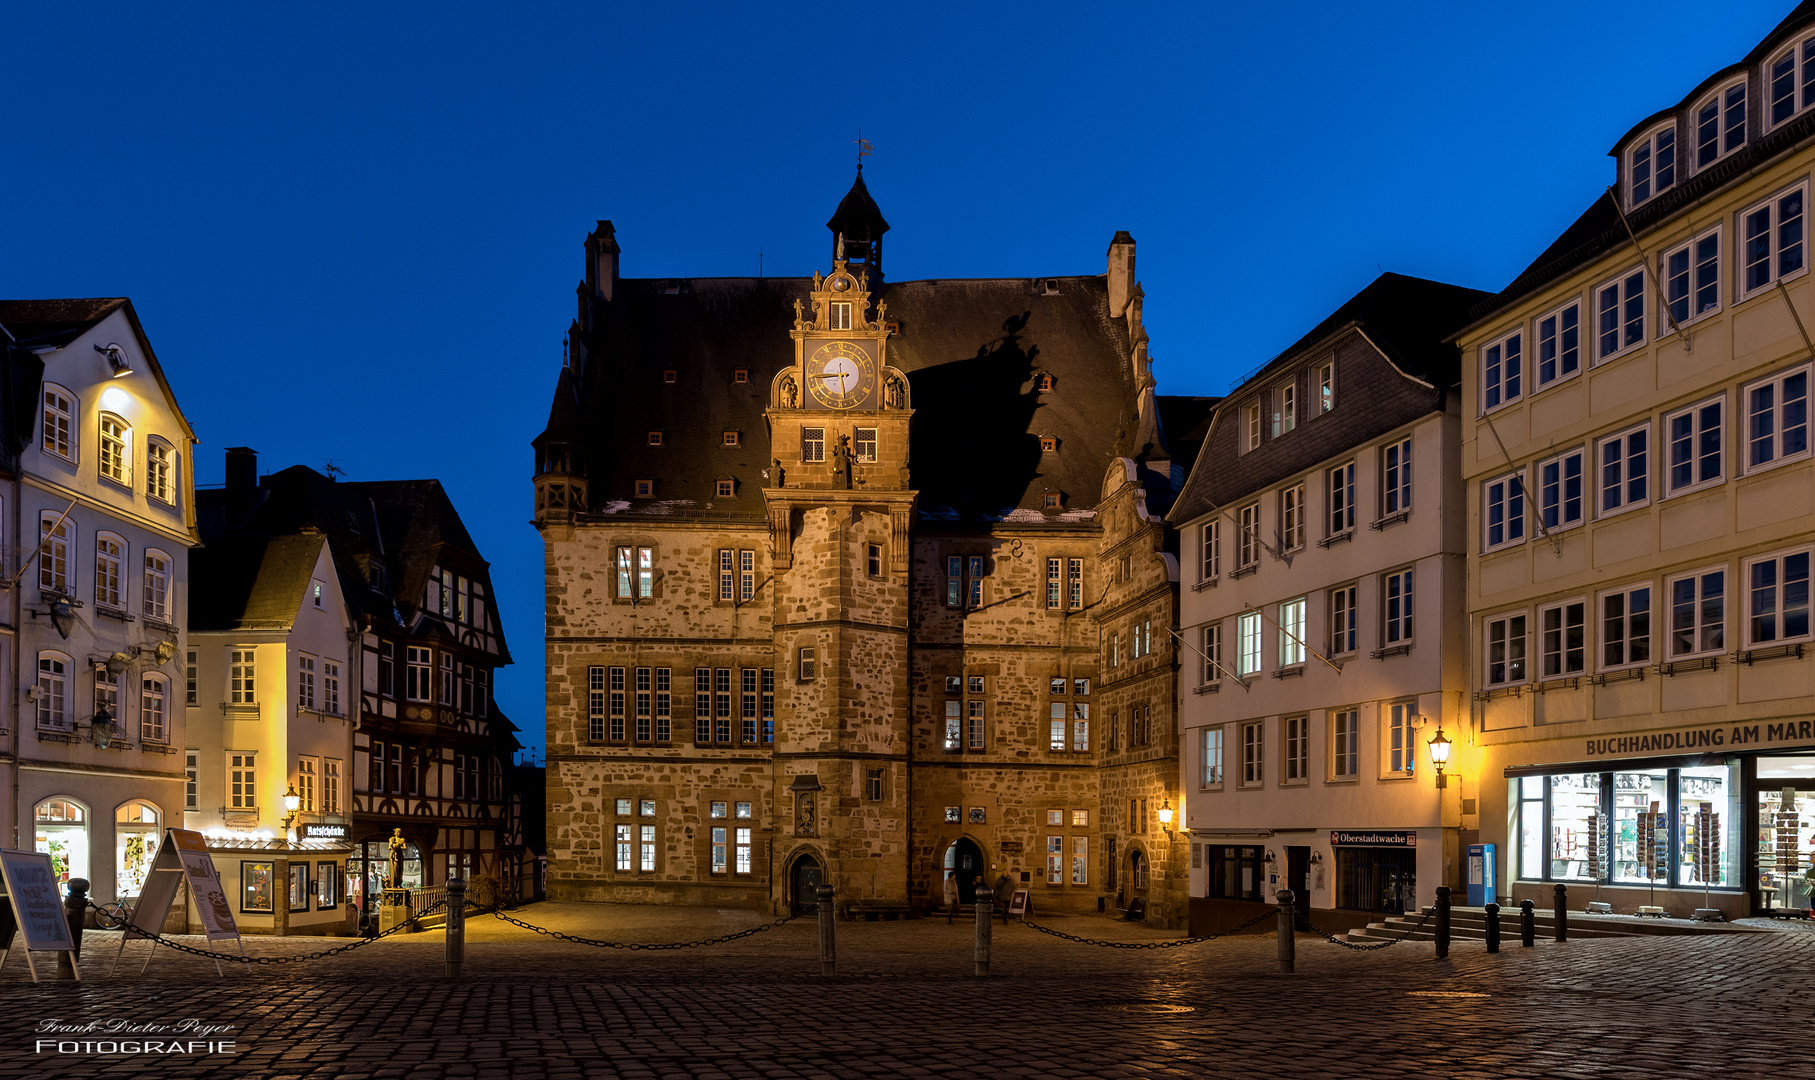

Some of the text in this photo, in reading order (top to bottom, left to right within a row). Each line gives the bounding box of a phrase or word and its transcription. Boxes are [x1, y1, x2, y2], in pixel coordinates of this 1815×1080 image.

[1587, 720, 1815, 755] BUCHHANDLUNG AM MAR
[1340, 833, 1406, 843] Oberstadtwache
